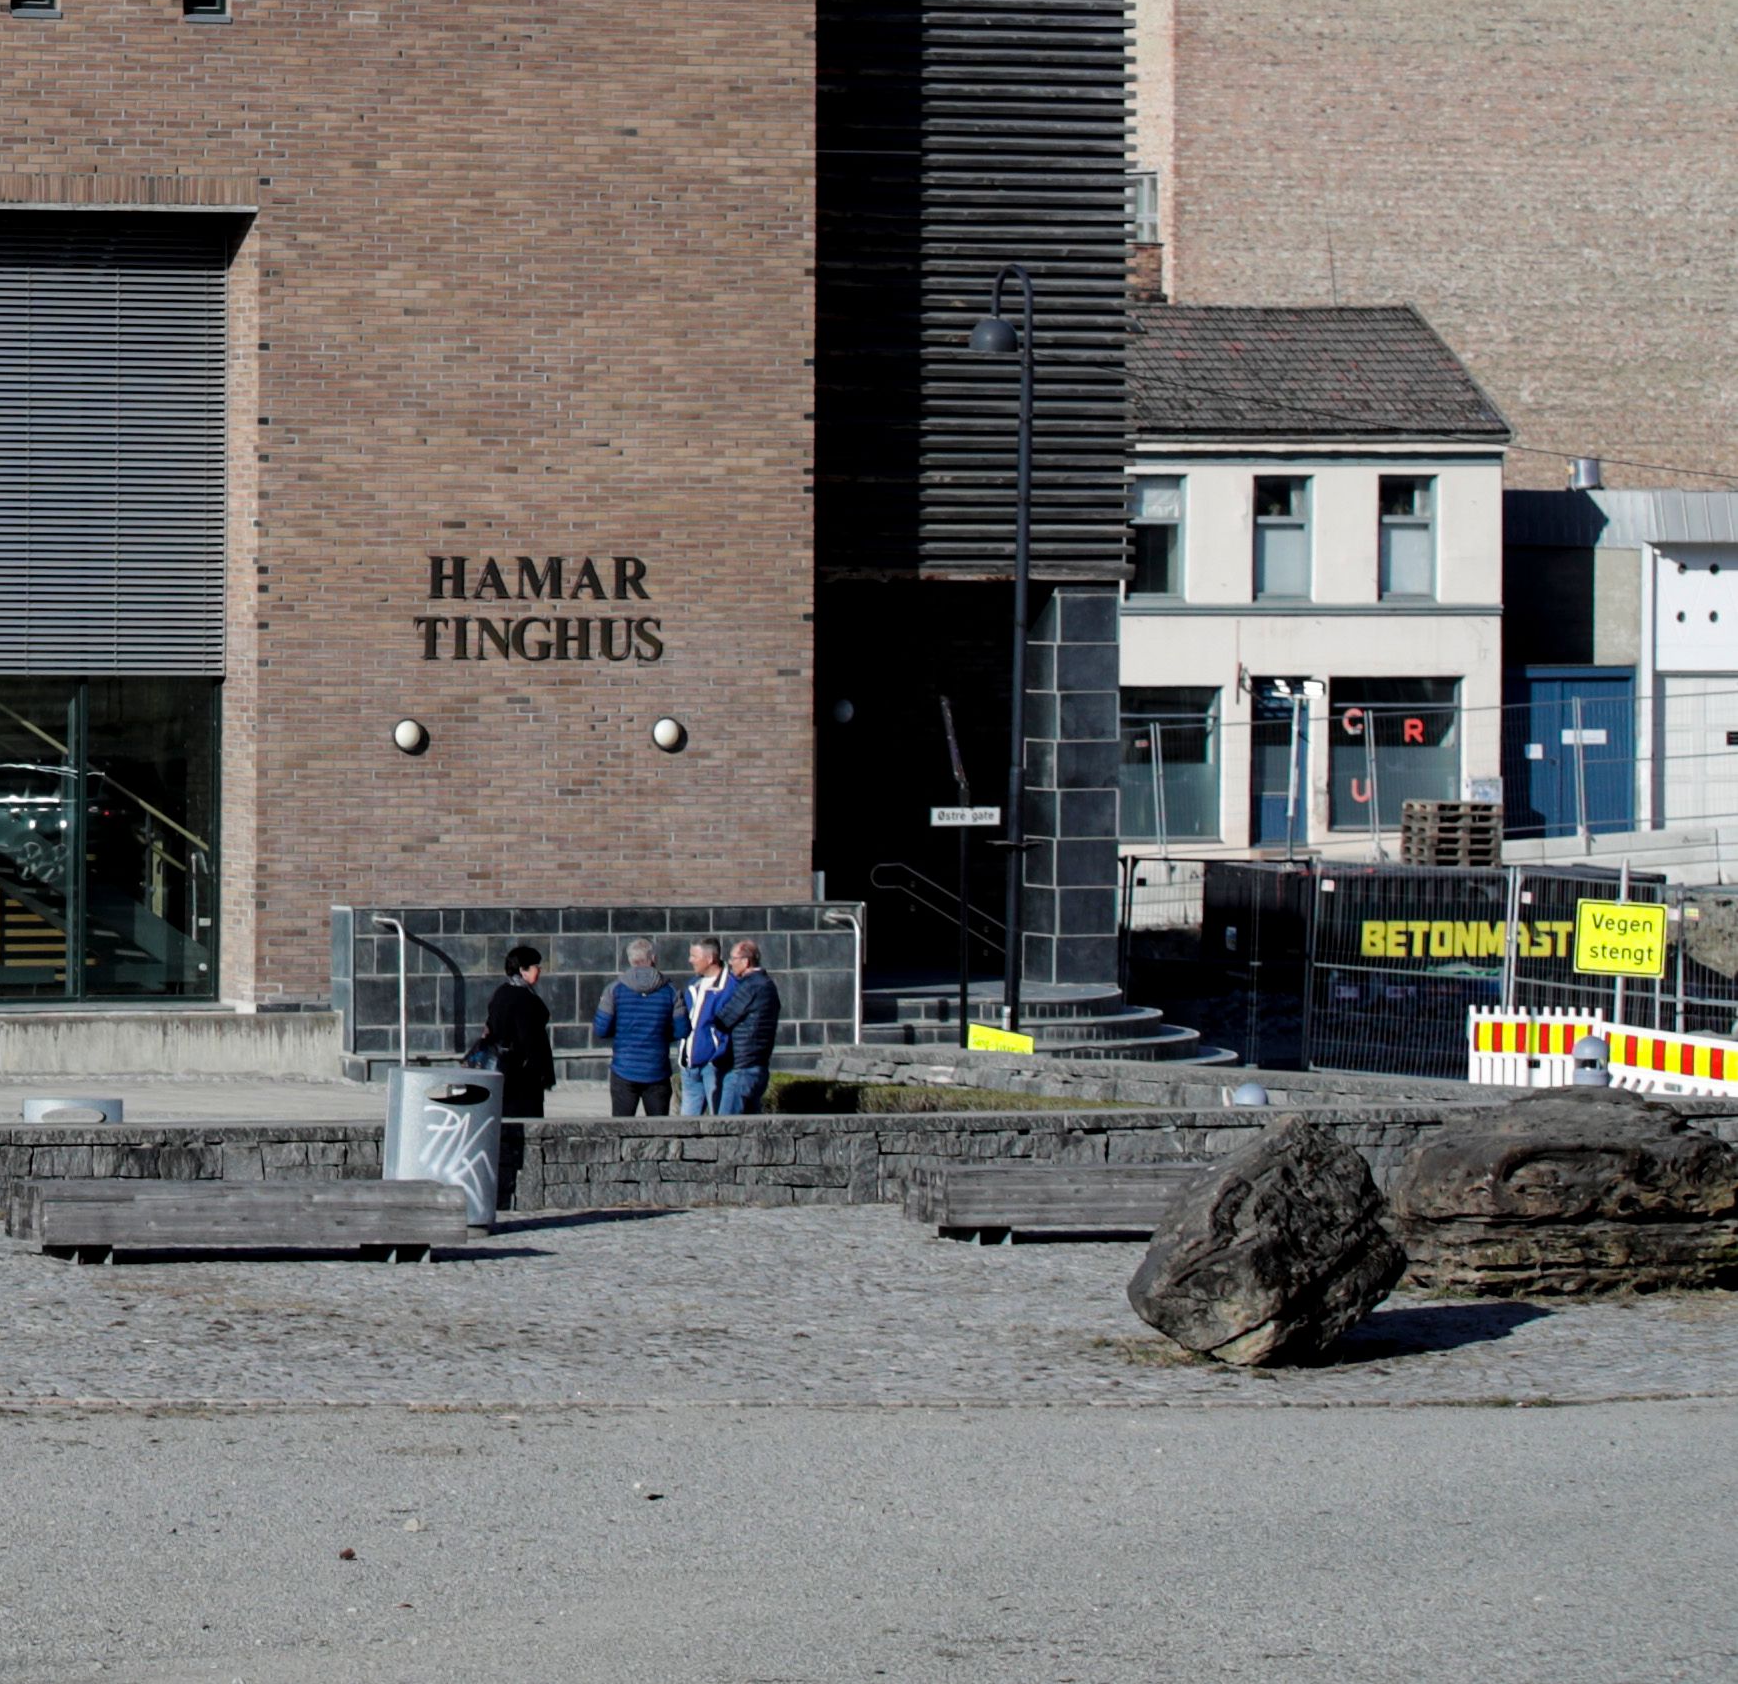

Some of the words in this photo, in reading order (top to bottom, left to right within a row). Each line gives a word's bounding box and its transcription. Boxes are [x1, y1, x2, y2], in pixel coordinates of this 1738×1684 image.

[427, 556, 651, 600] HAMAR
[414, 617, 664, 661] TINGHUS
[1404, 718, 1424, 743] R
[1361, 920, 1574, 958] BETONMAST
[1592, 913, 1653, 936] Vegen
[1589, 943, 1654, 966] stengt
